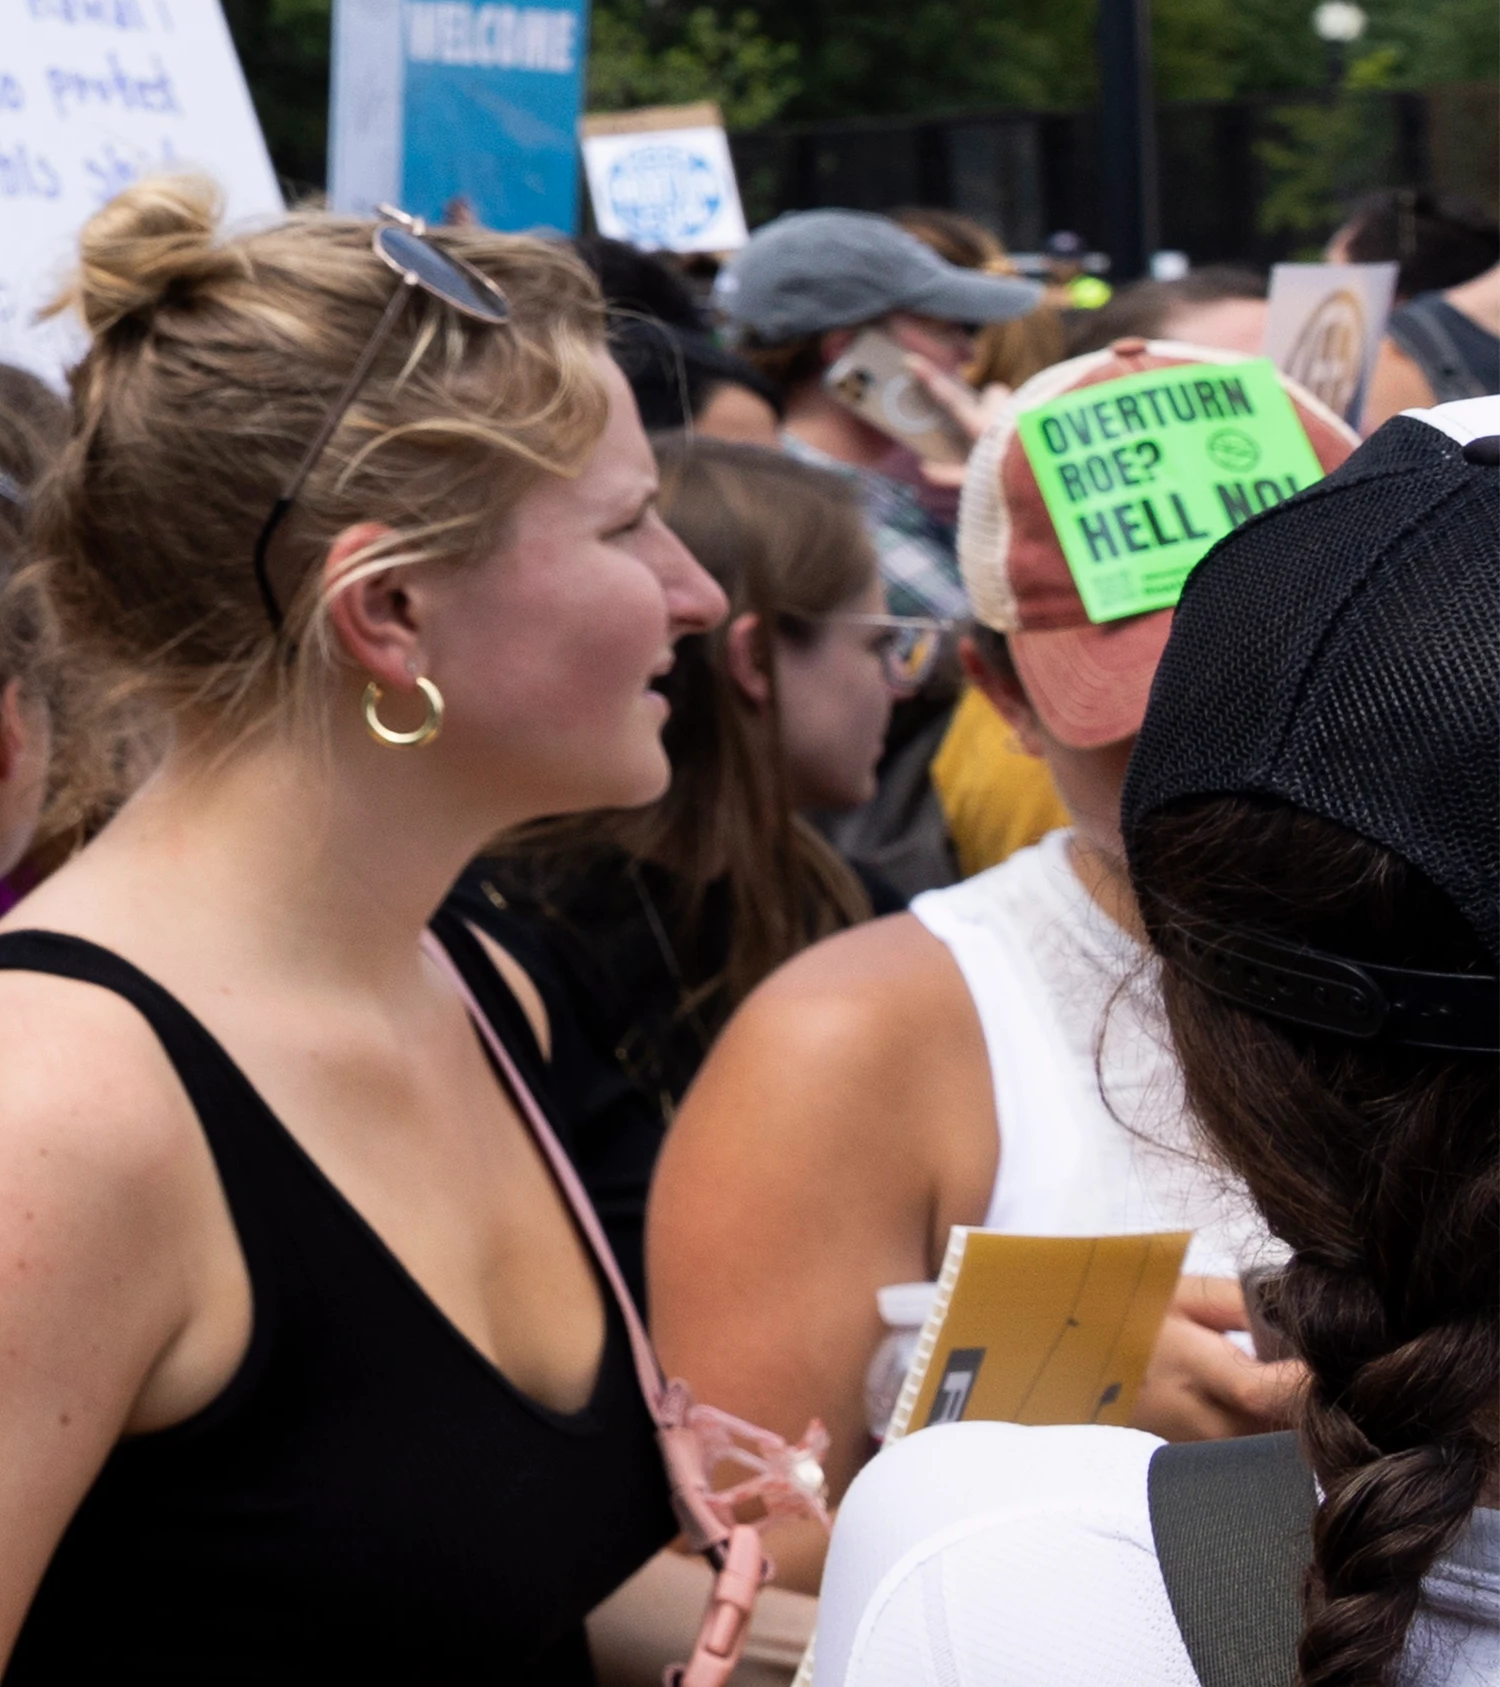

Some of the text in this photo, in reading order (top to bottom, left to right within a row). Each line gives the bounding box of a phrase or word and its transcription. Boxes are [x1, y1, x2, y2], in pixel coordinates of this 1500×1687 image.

[1040, 376, 1256, 458] OVERTURN
[1057, 440, 1162, 504] ROE?
[1076, 490, 1210, 563] HELL
